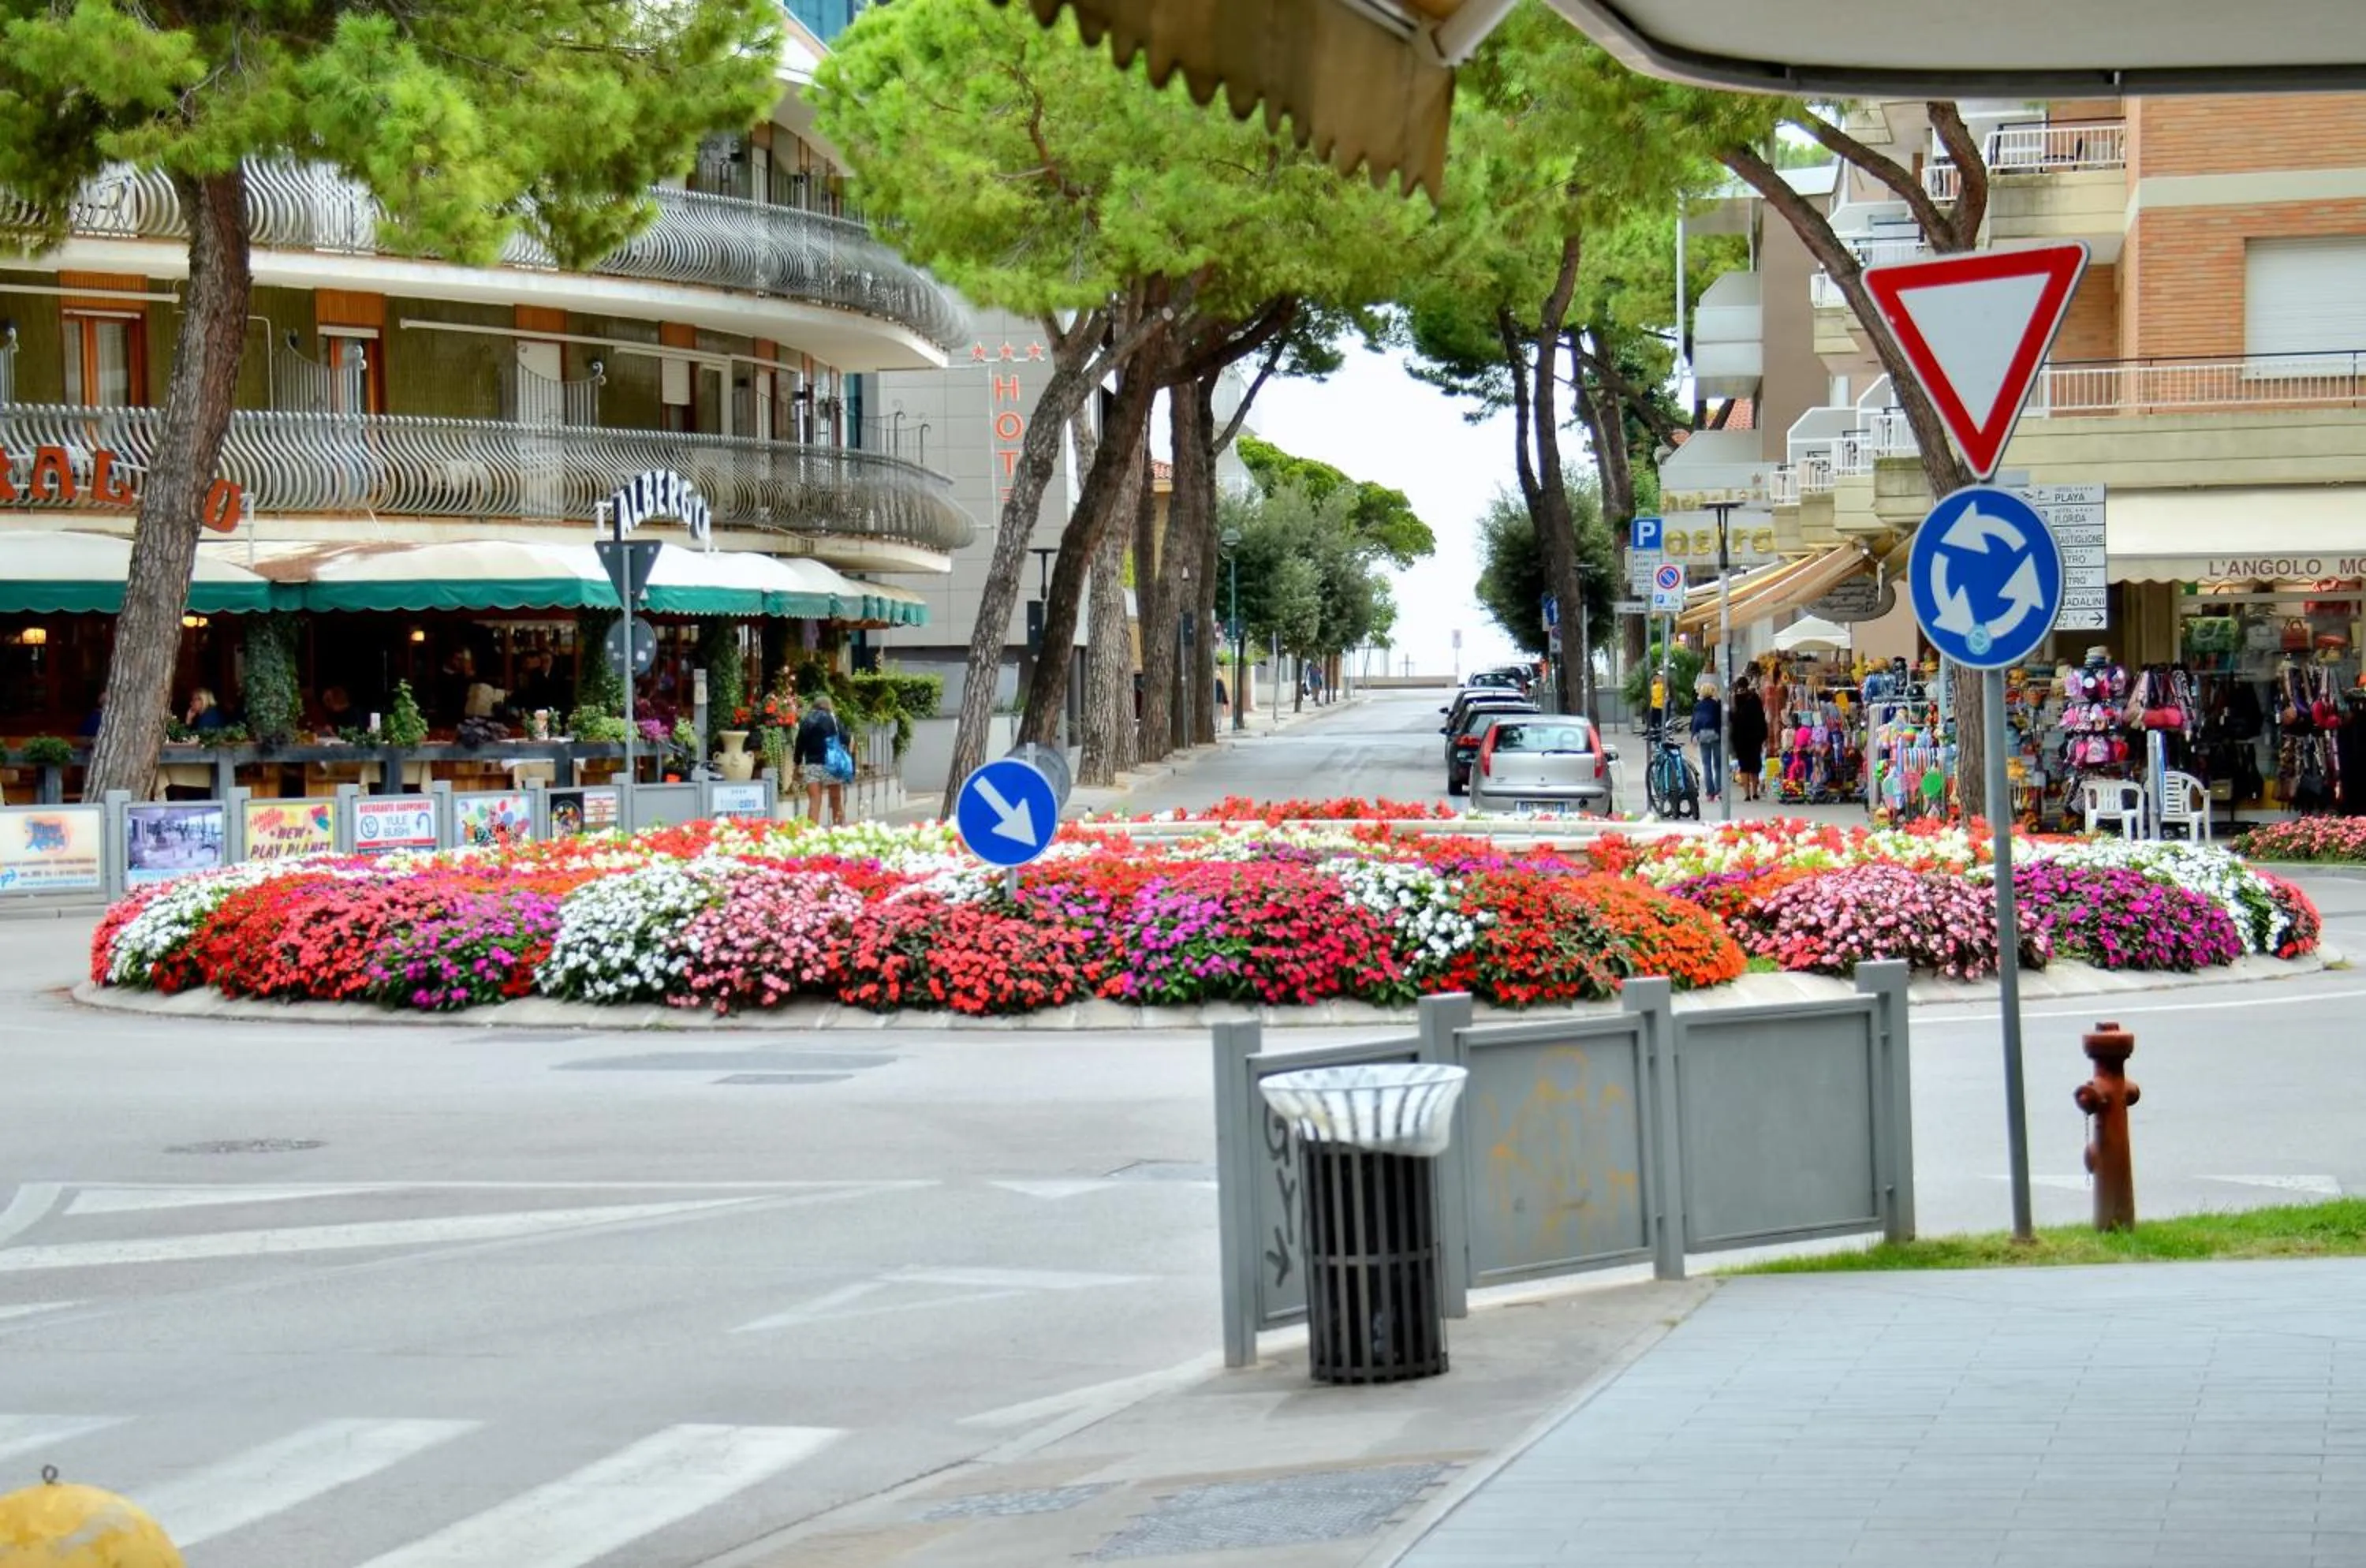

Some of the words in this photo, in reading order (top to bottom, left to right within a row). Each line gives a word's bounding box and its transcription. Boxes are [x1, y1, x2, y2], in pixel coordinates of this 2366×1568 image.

[619, 469, 710, 541] ALBERGO
[2054, 492, 2085, 502] PLAYA
[1637, 521, 1655, 546] P
[2209, 558, 2322, 577] L'ANGOLO
[278, 827, 306, 840] NEW
[251, 843, 282, 859] PLAY
